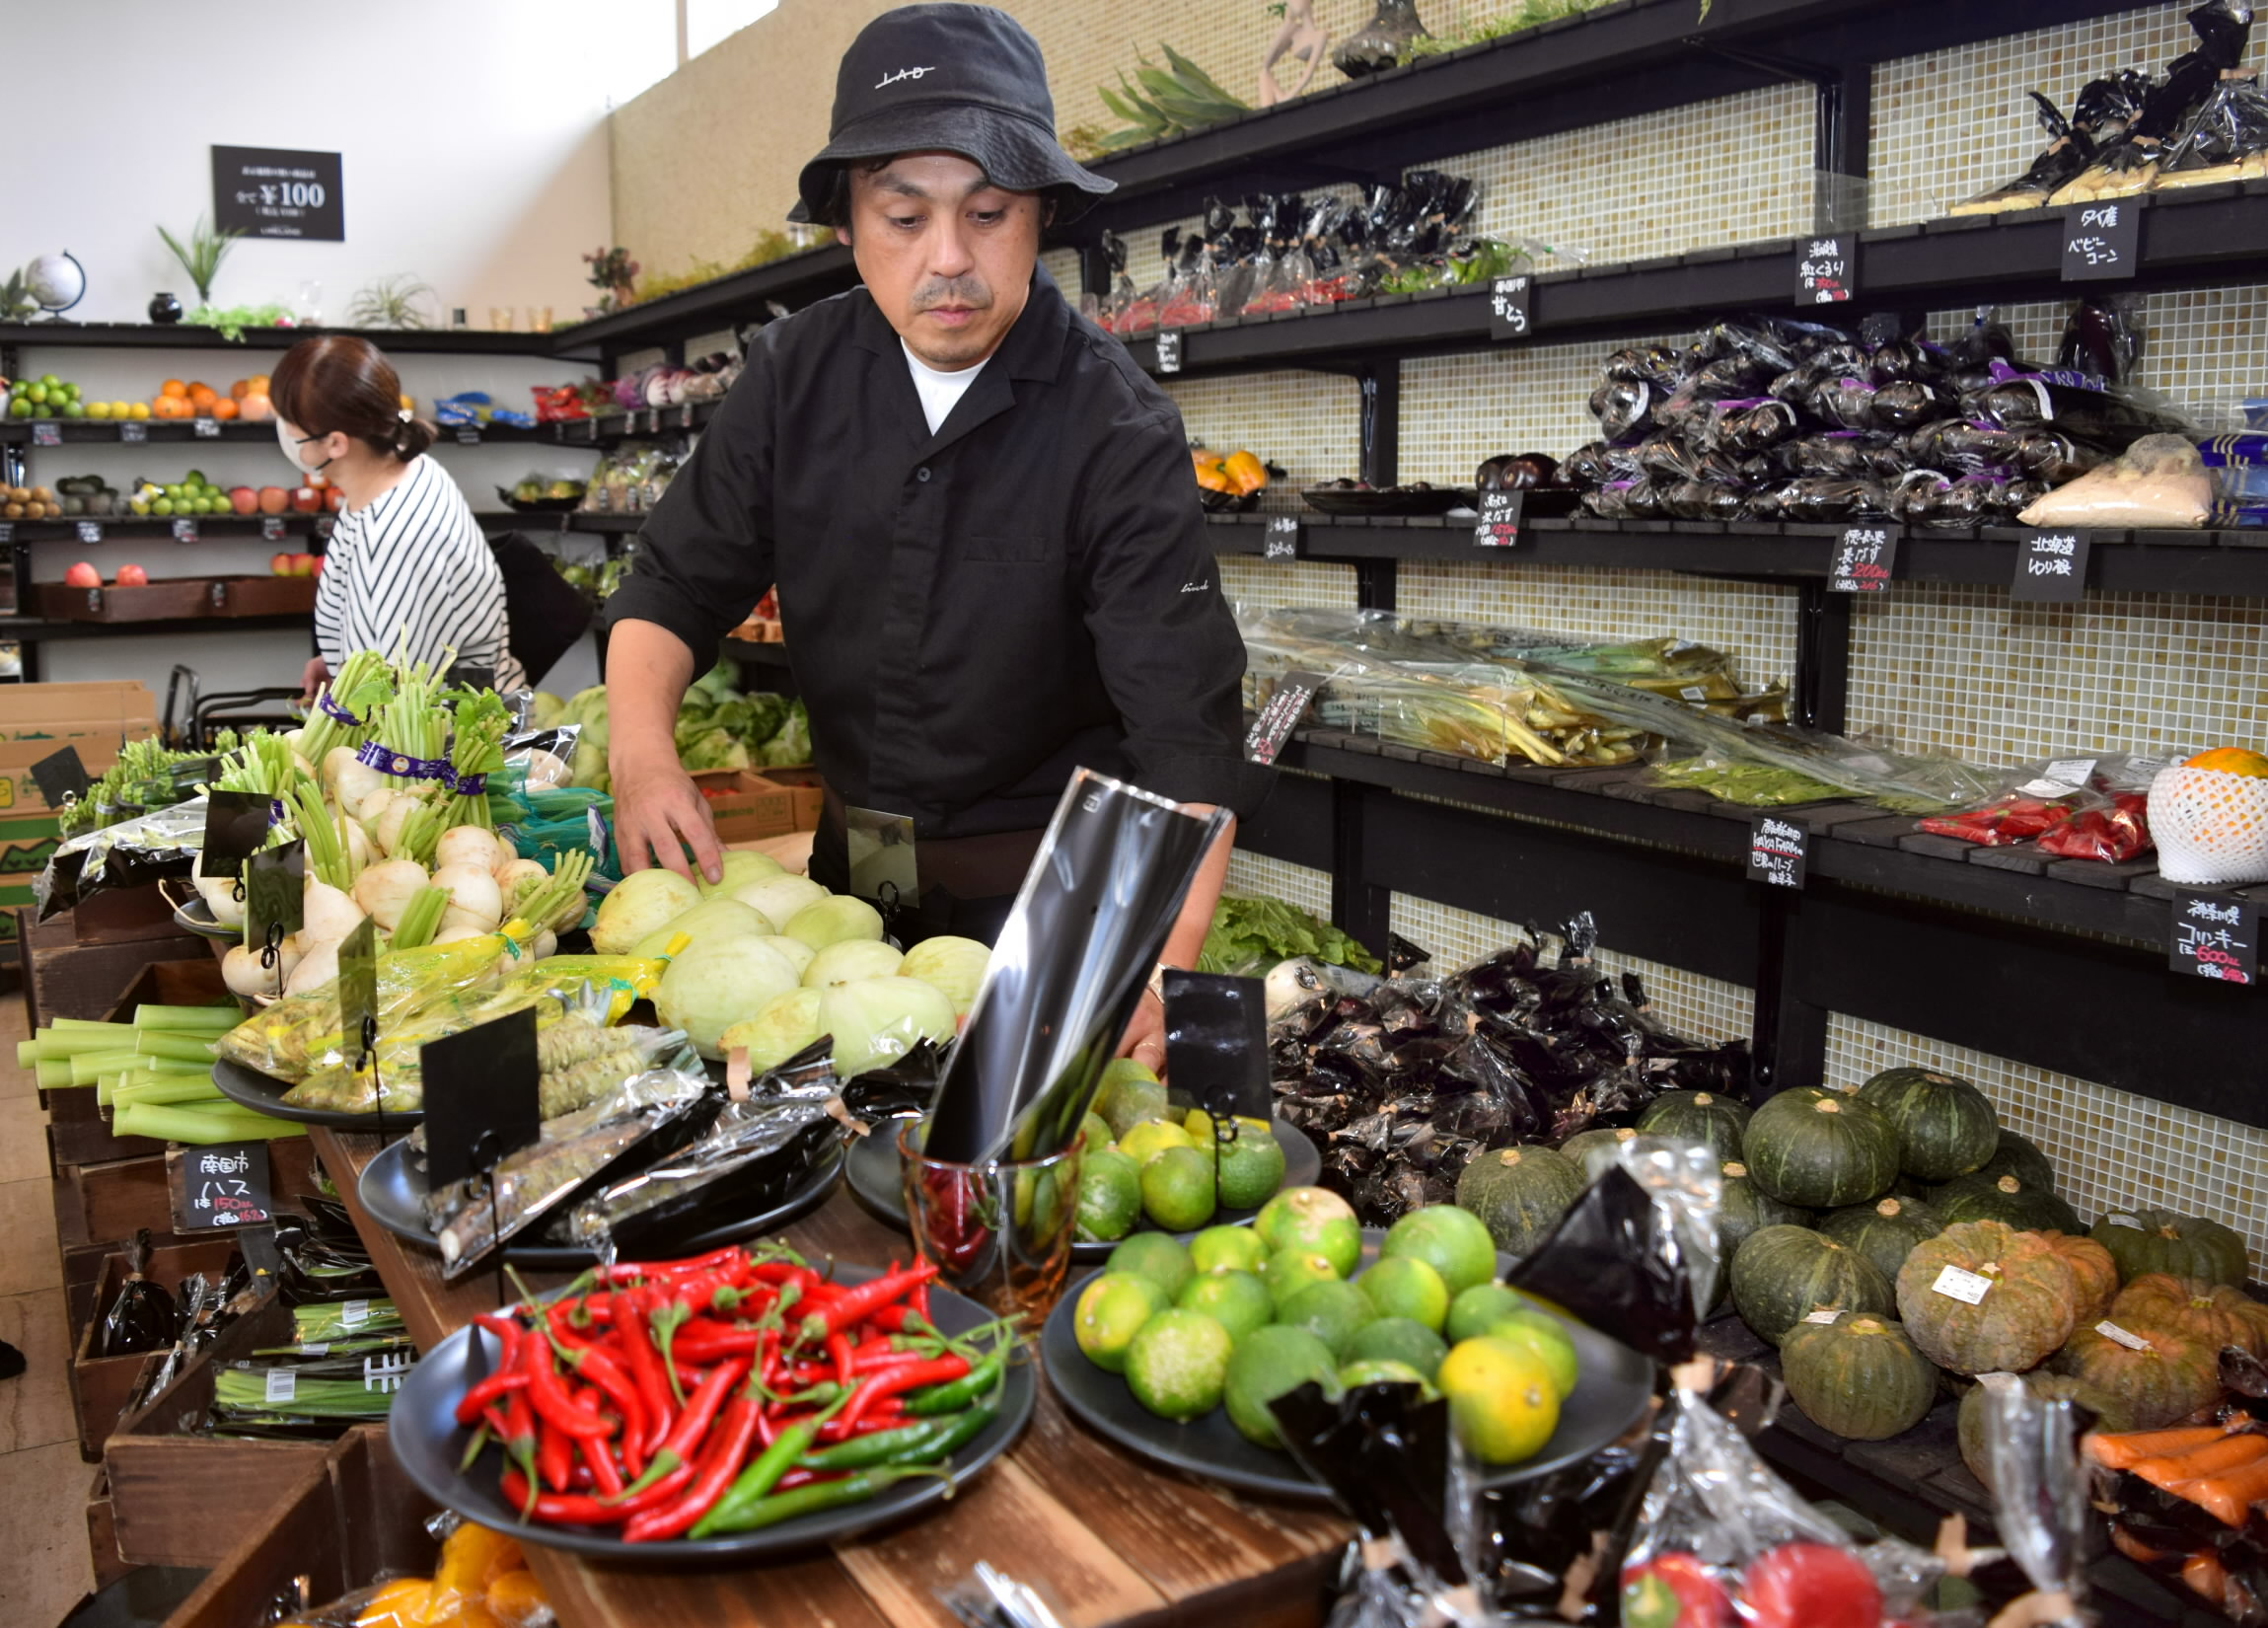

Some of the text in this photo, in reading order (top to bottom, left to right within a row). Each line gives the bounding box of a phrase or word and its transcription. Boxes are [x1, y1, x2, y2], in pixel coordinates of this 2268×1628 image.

[259, 182, 326, 208] ¥100
[2081, 204, 2118, 228] タイ産
[2068, 237, 2106, 253] ベビー
[2085, 248, 2119, 264] コーン
[1800, 260, 1844, 277] 紅くるり
[1492, 295, 1526, 332] 甘とう
[1838, 545, 1881, 564] 長なす
[2030, 535, 2077, 555] 北海道
[2028, 557, 2073, 576] ゆり根
[2177, 922, 2248, 949] コリンキー
[200, 1150, 249, 1174] 南国市
[201, 1179, 252, 1197] ハス
